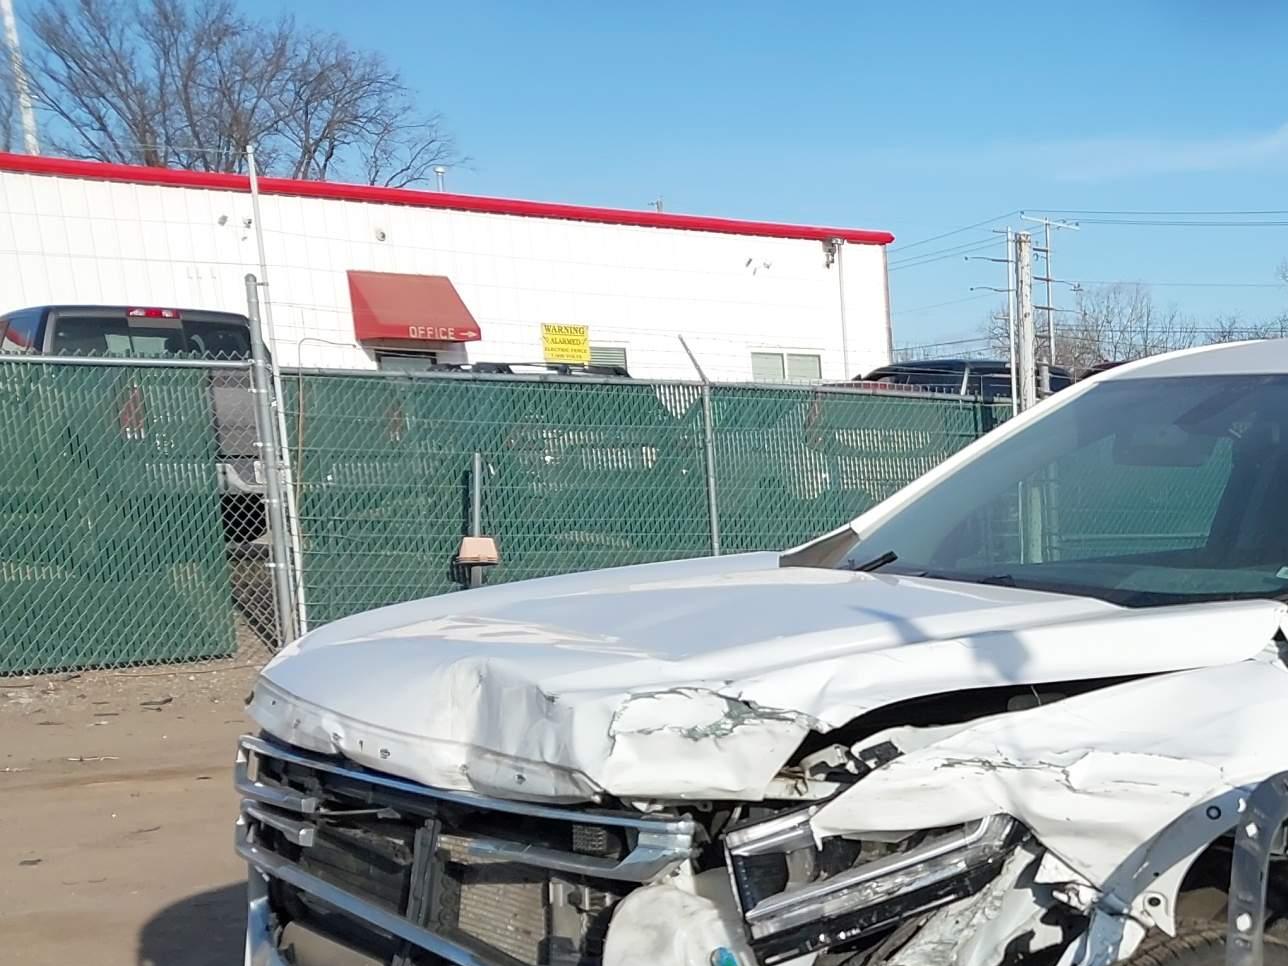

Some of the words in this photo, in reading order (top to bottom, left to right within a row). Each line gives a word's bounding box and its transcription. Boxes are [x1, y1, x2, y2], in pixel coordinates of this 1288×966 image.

[408, 326, 456, 339] OFFICE
[543, 324, 585, 335] WARNING
[550, 337, 581, 345] ALARMED
